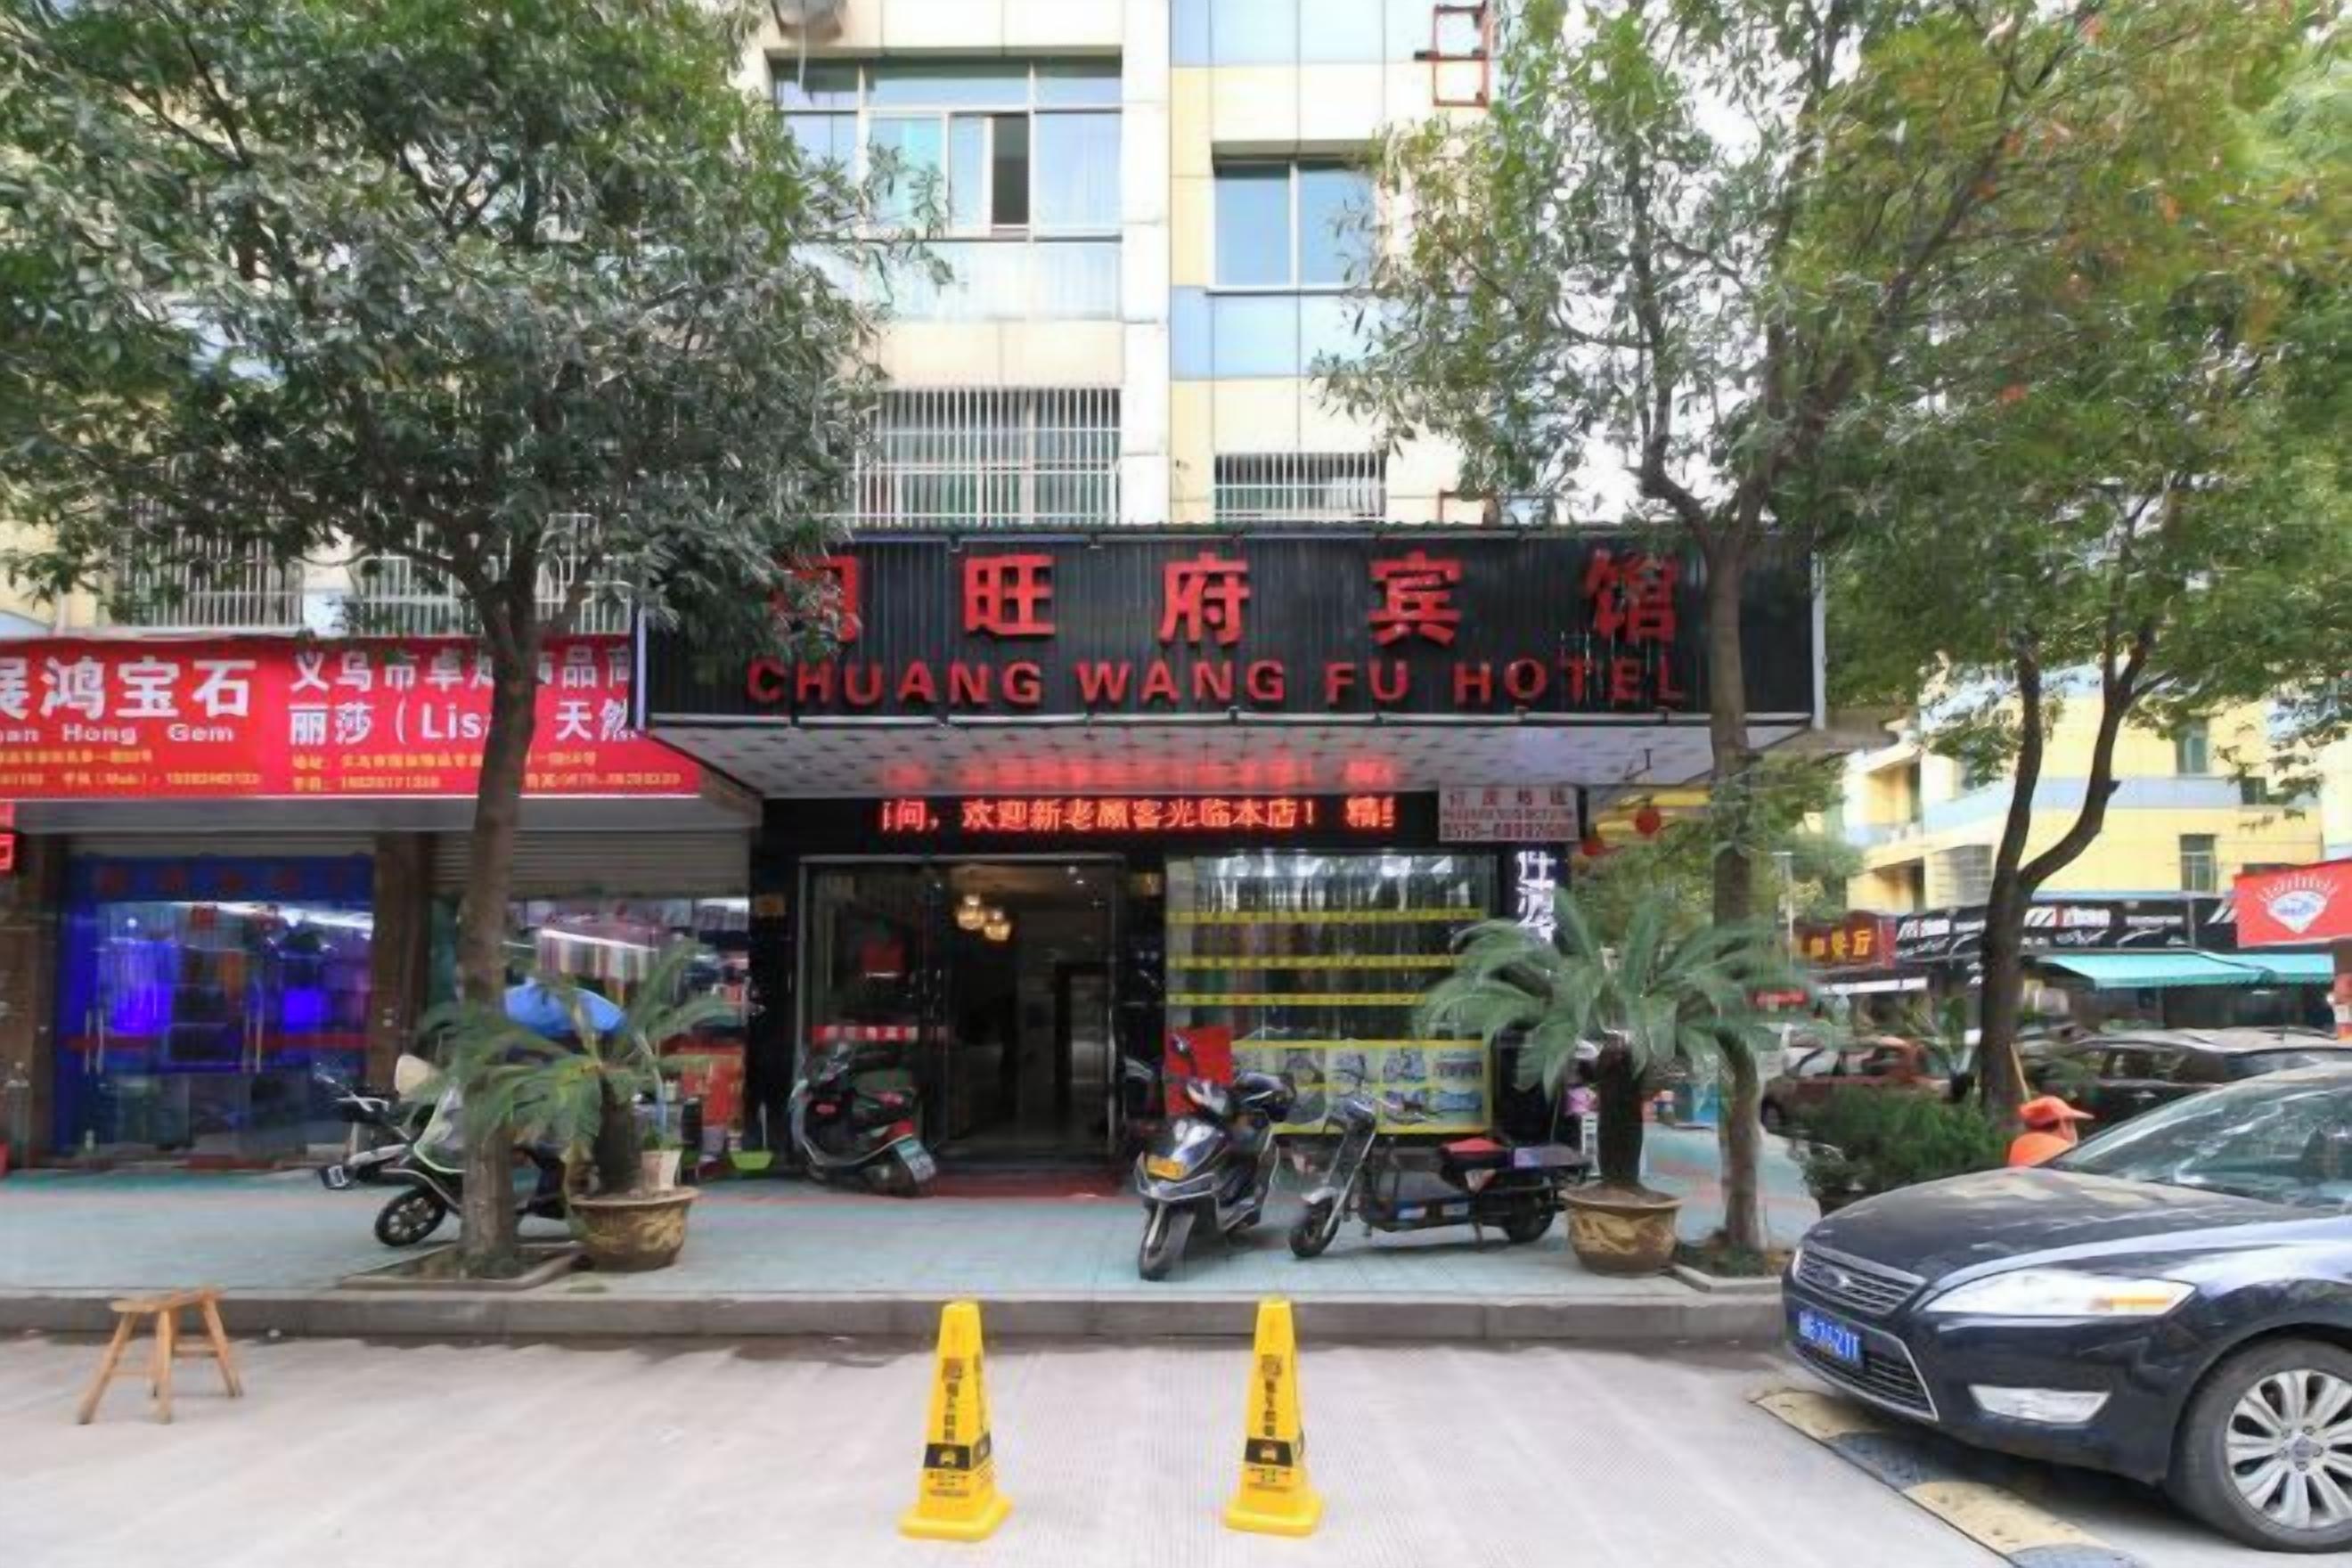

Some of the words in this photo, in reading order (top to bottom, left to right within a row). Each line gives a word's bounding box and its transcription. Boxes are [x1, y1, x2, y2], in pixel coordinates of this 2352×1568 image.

[747, 658, 1043, 705] CHUANG
[1074, 657, 1286, 705] WANG
[1323, 658, 1409, 702] FU
[1452, 657, 1686, 704] HOTEL
[0, 727, 39, 742] an
[62, 723, 137, 745] Hong
[167, 723, 233, 742] Gem
